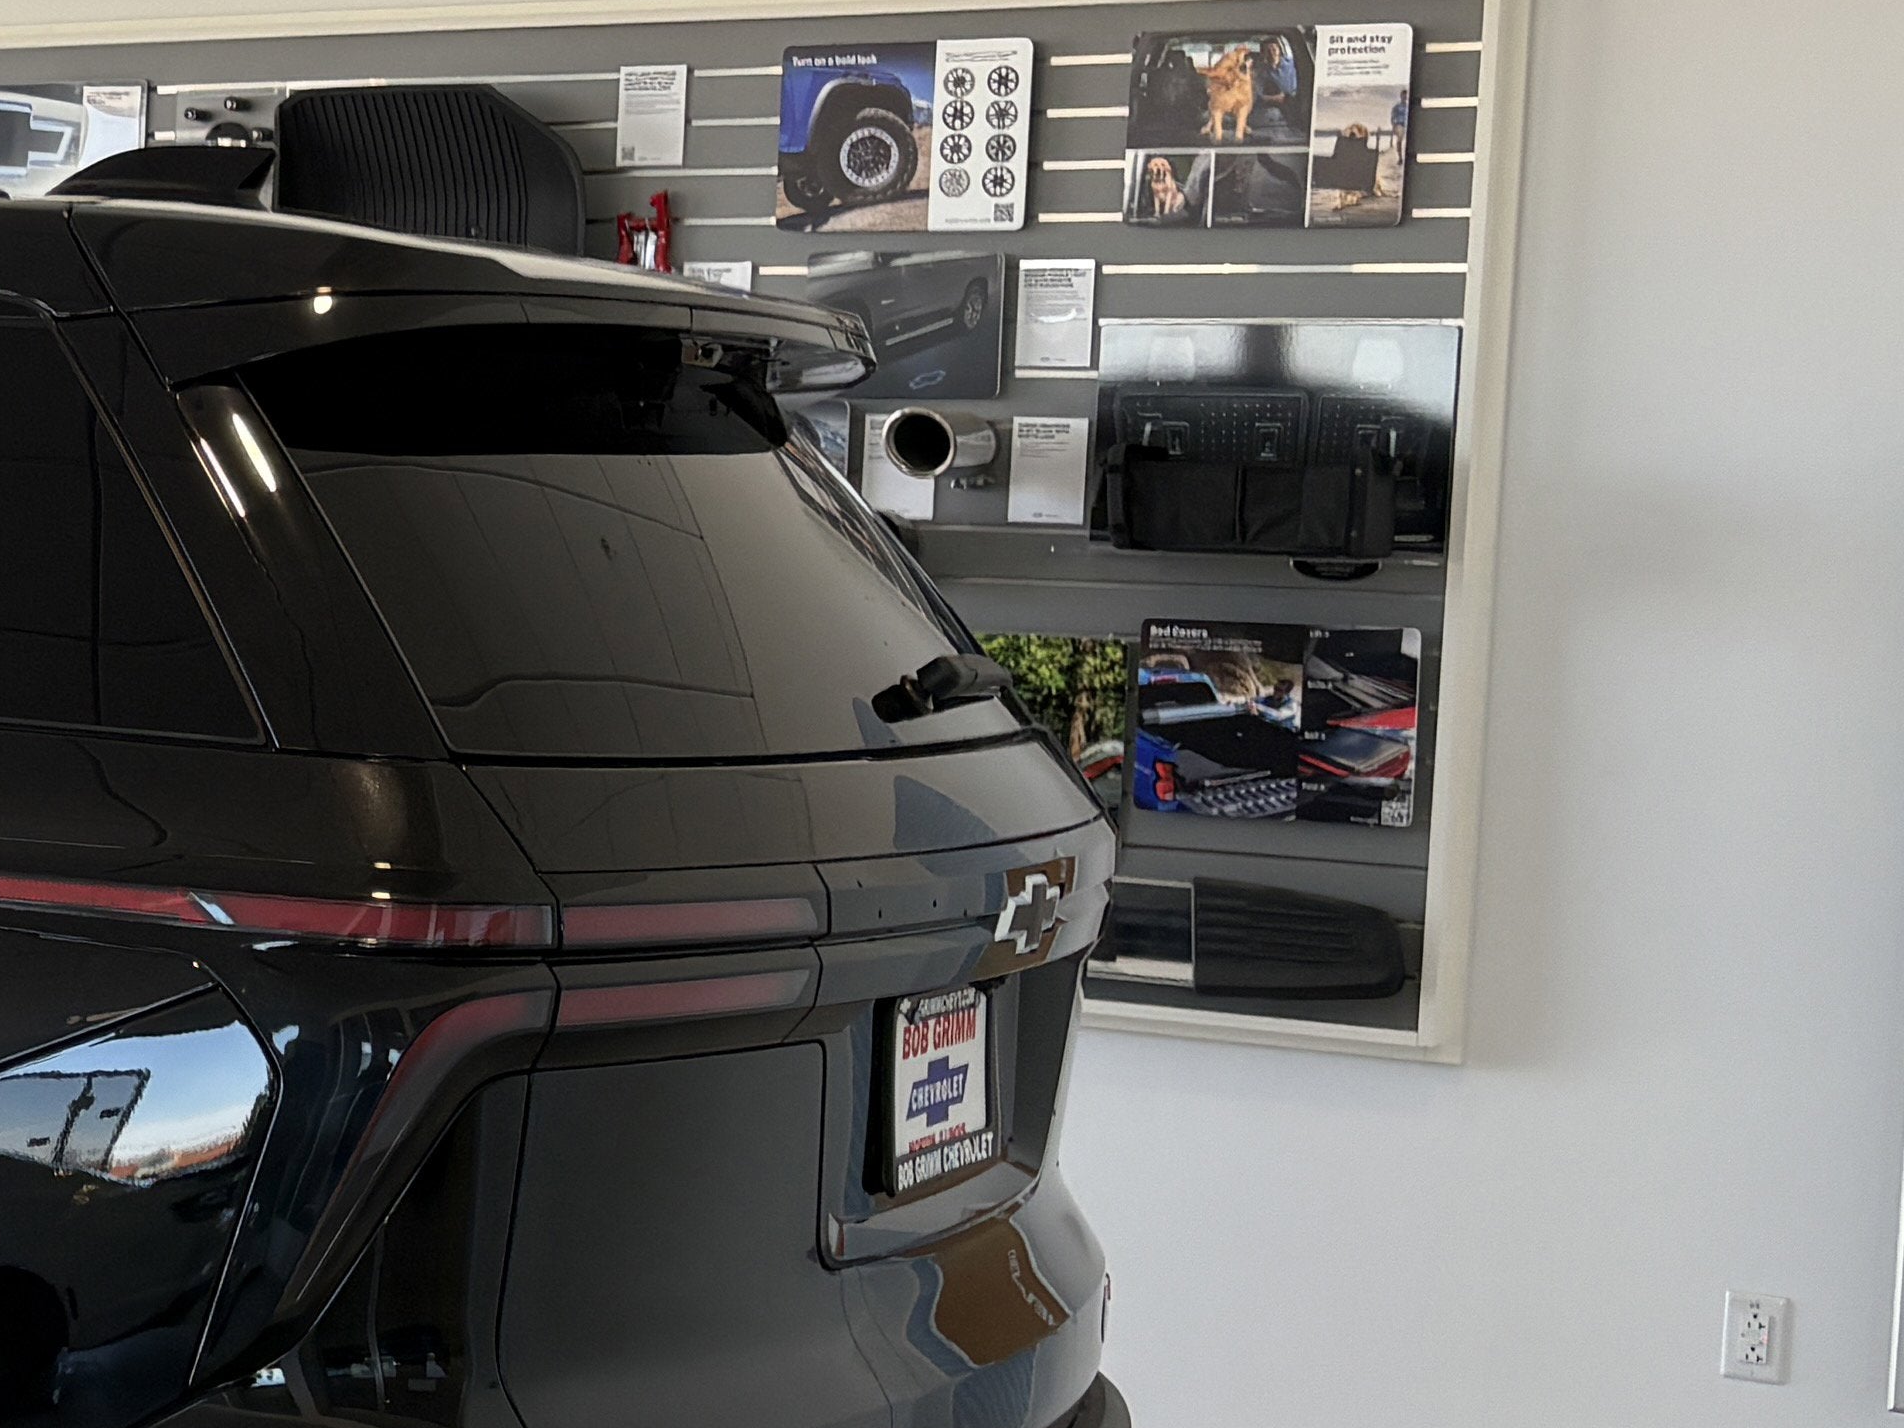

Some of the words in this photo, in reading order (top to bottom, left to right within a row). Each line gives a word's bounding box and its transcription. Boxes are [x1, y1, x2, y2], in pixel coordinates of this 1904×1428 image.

[1328, 45, 1386, 57] protection
[1329, 35, 1344, 45] Sit
[1347, 35, 1367, 44] and
[1369, 35, 1393, 45] stay
[792, 56, 813, 67] Turn
[902, 1020, 929, 1060] BOB
[933, 1007, 977, 1049] GRIMM
[911, 1072, 965, 1112] CHEVROLET
[898, 1159, 914, 1191] BOB
[915, 1148, 942, 1183] GRIMM
[943, 1131, 994, 1173] CHEVROLET
